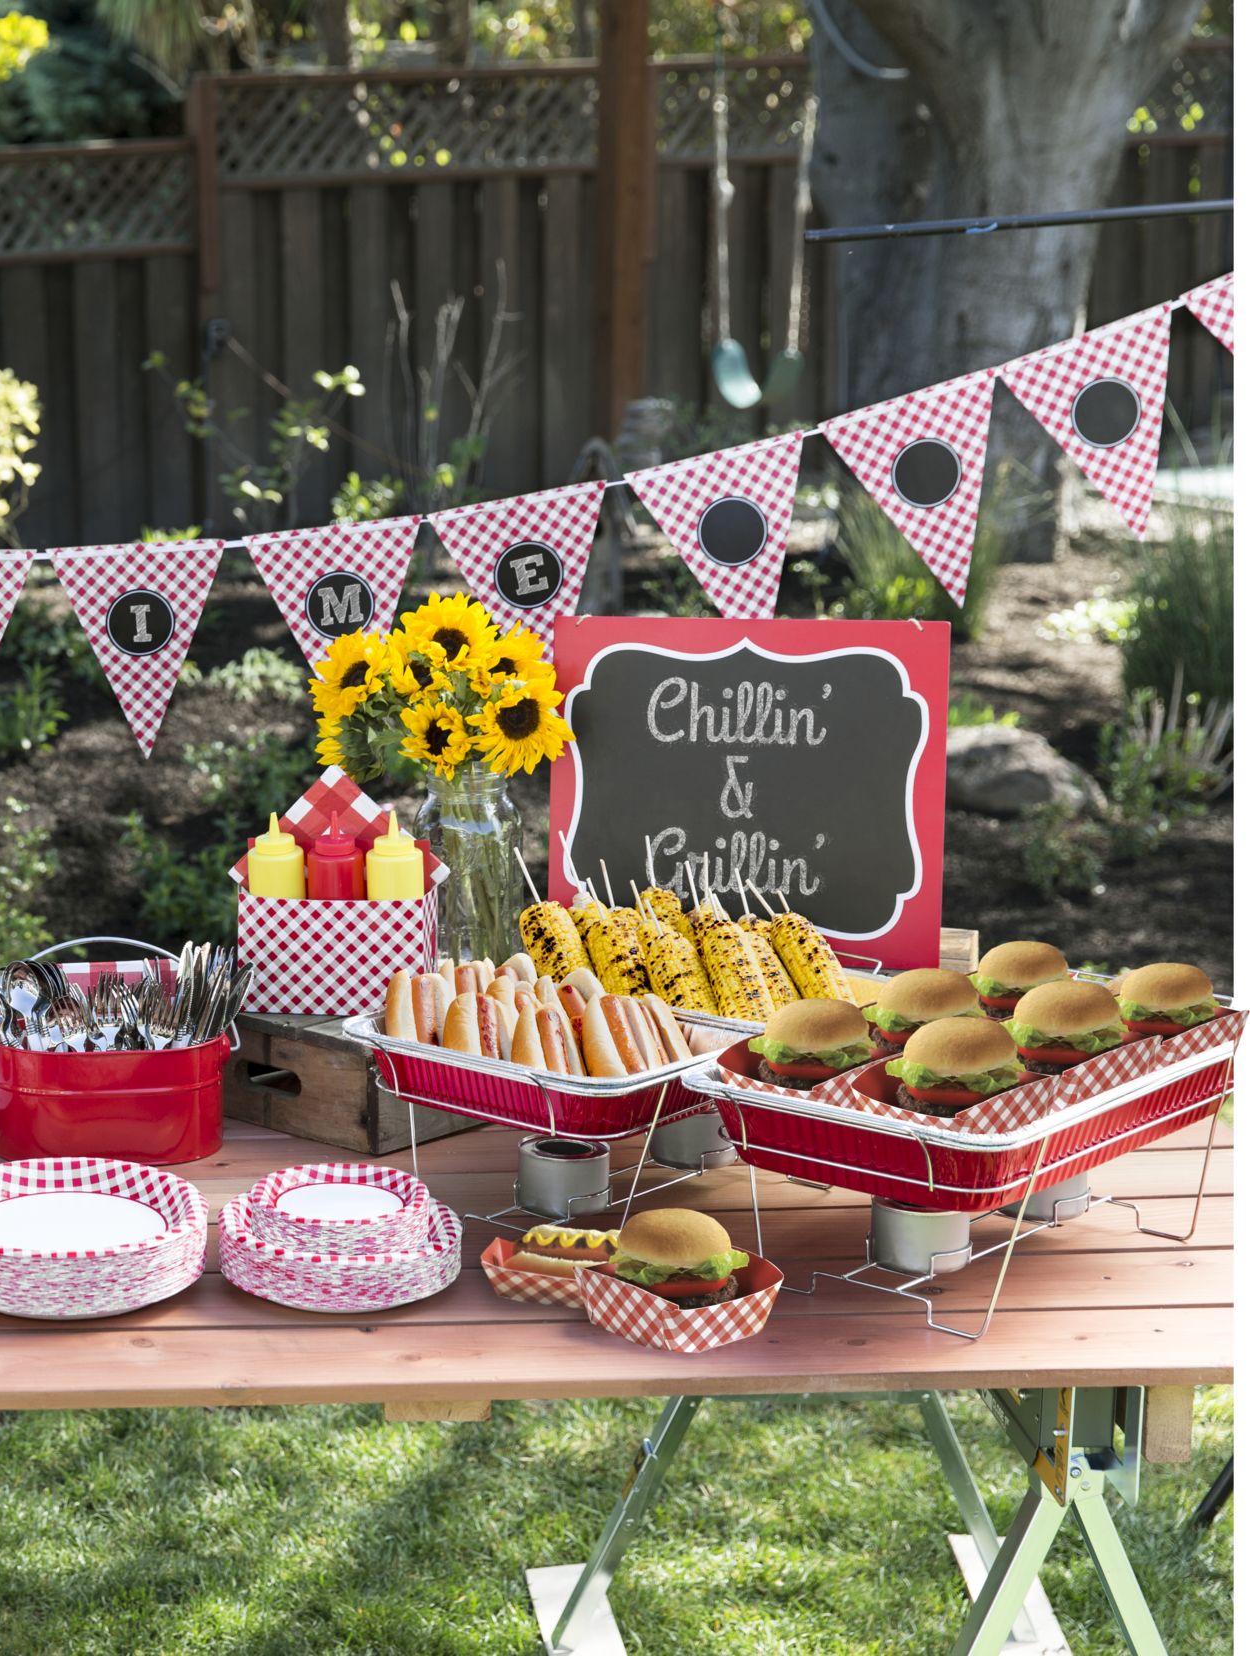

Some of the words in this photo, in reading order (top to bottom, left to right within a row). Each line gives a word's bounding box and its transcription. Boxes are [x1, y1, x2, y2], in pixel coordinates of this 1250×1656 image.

[130, 605, 152, 642] I
[318, 584, 364, 626] M
[510, 554, 549, 595] E
[647, 676, 832, 746] Chillin'
[720, 755, 754, 819] &
